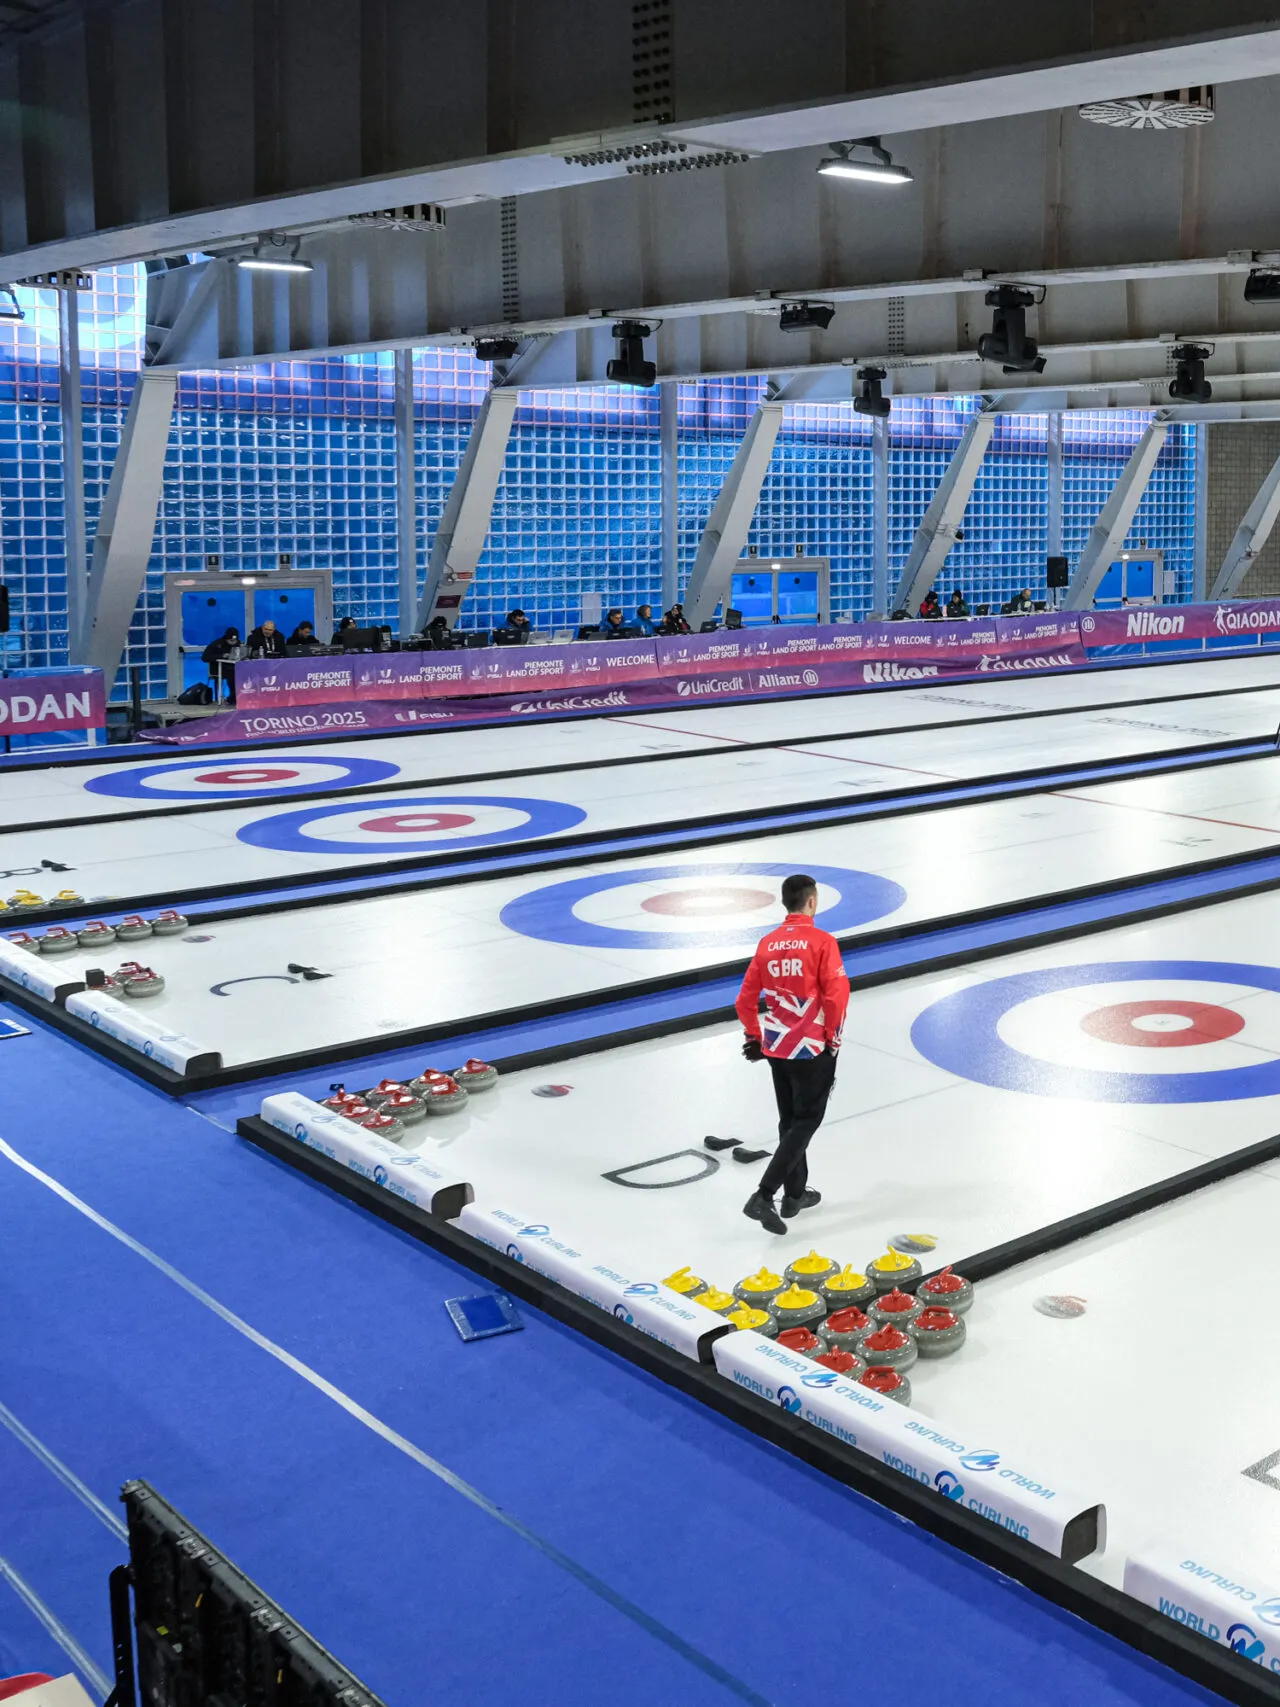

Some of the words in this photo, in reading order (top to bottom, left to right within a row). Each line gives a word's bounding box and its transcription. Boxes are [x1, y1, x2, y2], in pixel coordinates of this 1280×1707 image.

[1127, 613, 1185, 637] Nikon
[708, 644, 740, 652] PIEMONTE
[787, 638, 817, 646] PIEMONTE
[833, 635, 862, 643] PIEMONTE
[894, 635, 931, 645] WELCOME
[606, 654, 655, 667] WELCOME
[693, 653, 711, 661] LAND
[772, 646, 790, 655] LAND
[420, 665, 463, 674] PIEMONTE
[524, 659, 564, 668] PIEMONTE
[862, 662, 940, 683] Nikon
[285, 681, 309, 690] LAND
[311, 680, 323, 688] OF
[324, 678, 352, 688] SPORT
[307, 670, 352, 681] PIEMONTE
[399, 675, 422, 683] LAND
[424, 674, 435, 682] OF
[436, 672, 463, 681] SPORT
[691, 677, 743, 693] UniCredit
[758, 672, 802, 688] Allianz
[536, 690, 631, 710] UniCredit
[240, 713, 317, 733] TORINO
[322, 711, 366, 726] 2025
[768, 940, 808, 952] CARSON
[767, 958, 803, 977] GBR
[208, 975, 300, 996] C
[600, 1148, 720, 1189] D
[492, 1209, 524, 1227] WORLD
[540, 1237, 581, 1258] CURLING
[593, 1265, 630, 1284] WORLD
[650, 1296, 696, 1321] CURLING
[755, 1344, 808, 1373] CURLING
[734, 1370, 774, 1400] WORLD
[806, 1410, 857, 1446] CURLING
[835, 1386, 884, 1412] WORLD
[904, 1421, 965, 1452] CURLING
[999, 1469, 1056, 1499] WORLD
[883, 1451, 930, 1486] WORLD
[968, 1499, 1030, 1540] CURLING
[1180, 1559, 1257, 1600] CURLING
[1159, 1597, 1221, 1641] WORLD
